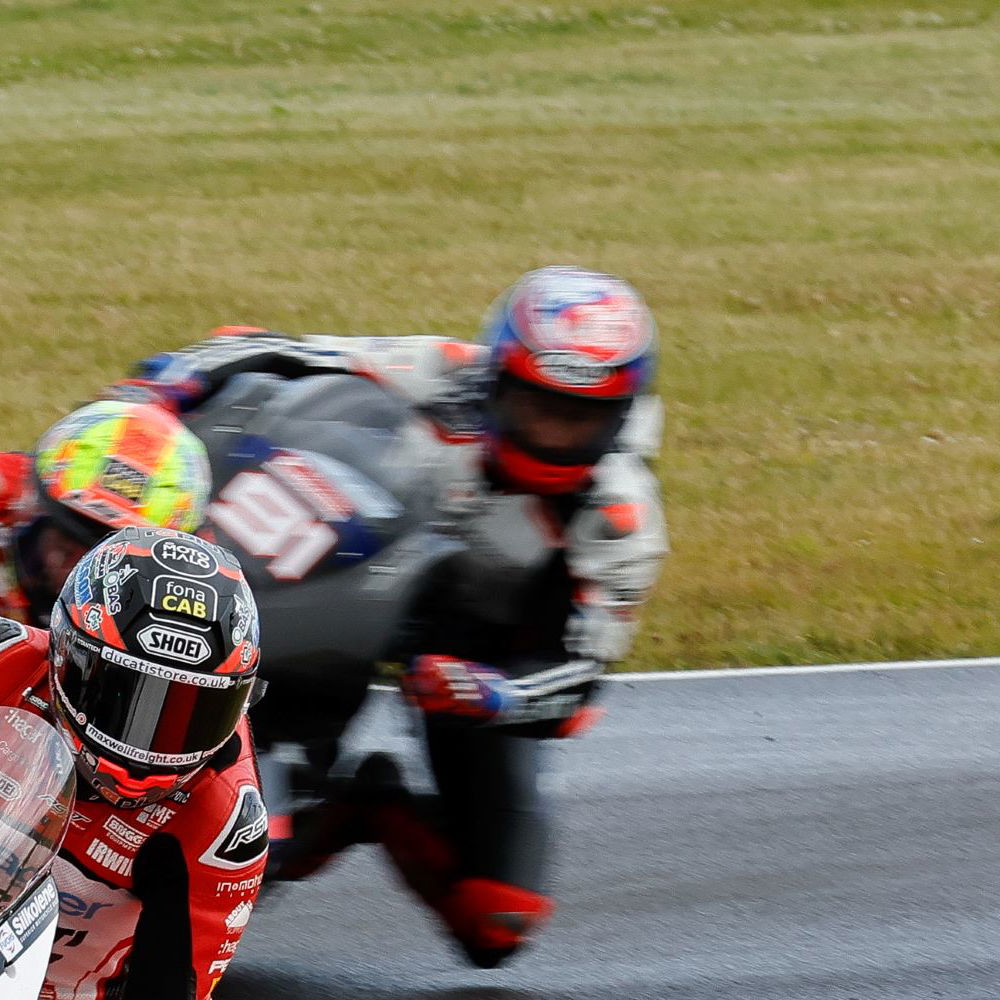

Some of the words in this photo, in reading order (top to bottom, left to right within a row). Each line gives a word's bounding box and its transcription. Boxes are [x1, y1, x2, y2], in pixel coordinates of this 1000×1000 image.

[161, 550, 211, 569] HALO
[162, 541, 210, 561] MOTO
[166, 582, 205, 602] fona
[162, 595, 207, 619] CAB
[149, 630, 201, 659] SHOEI
[105, 648, 227, 689] ducatistore.co.uk
[88, 725, 199, 764] maxwellfreight.co.uk
[11, 882, 57, 936] Silkolene
